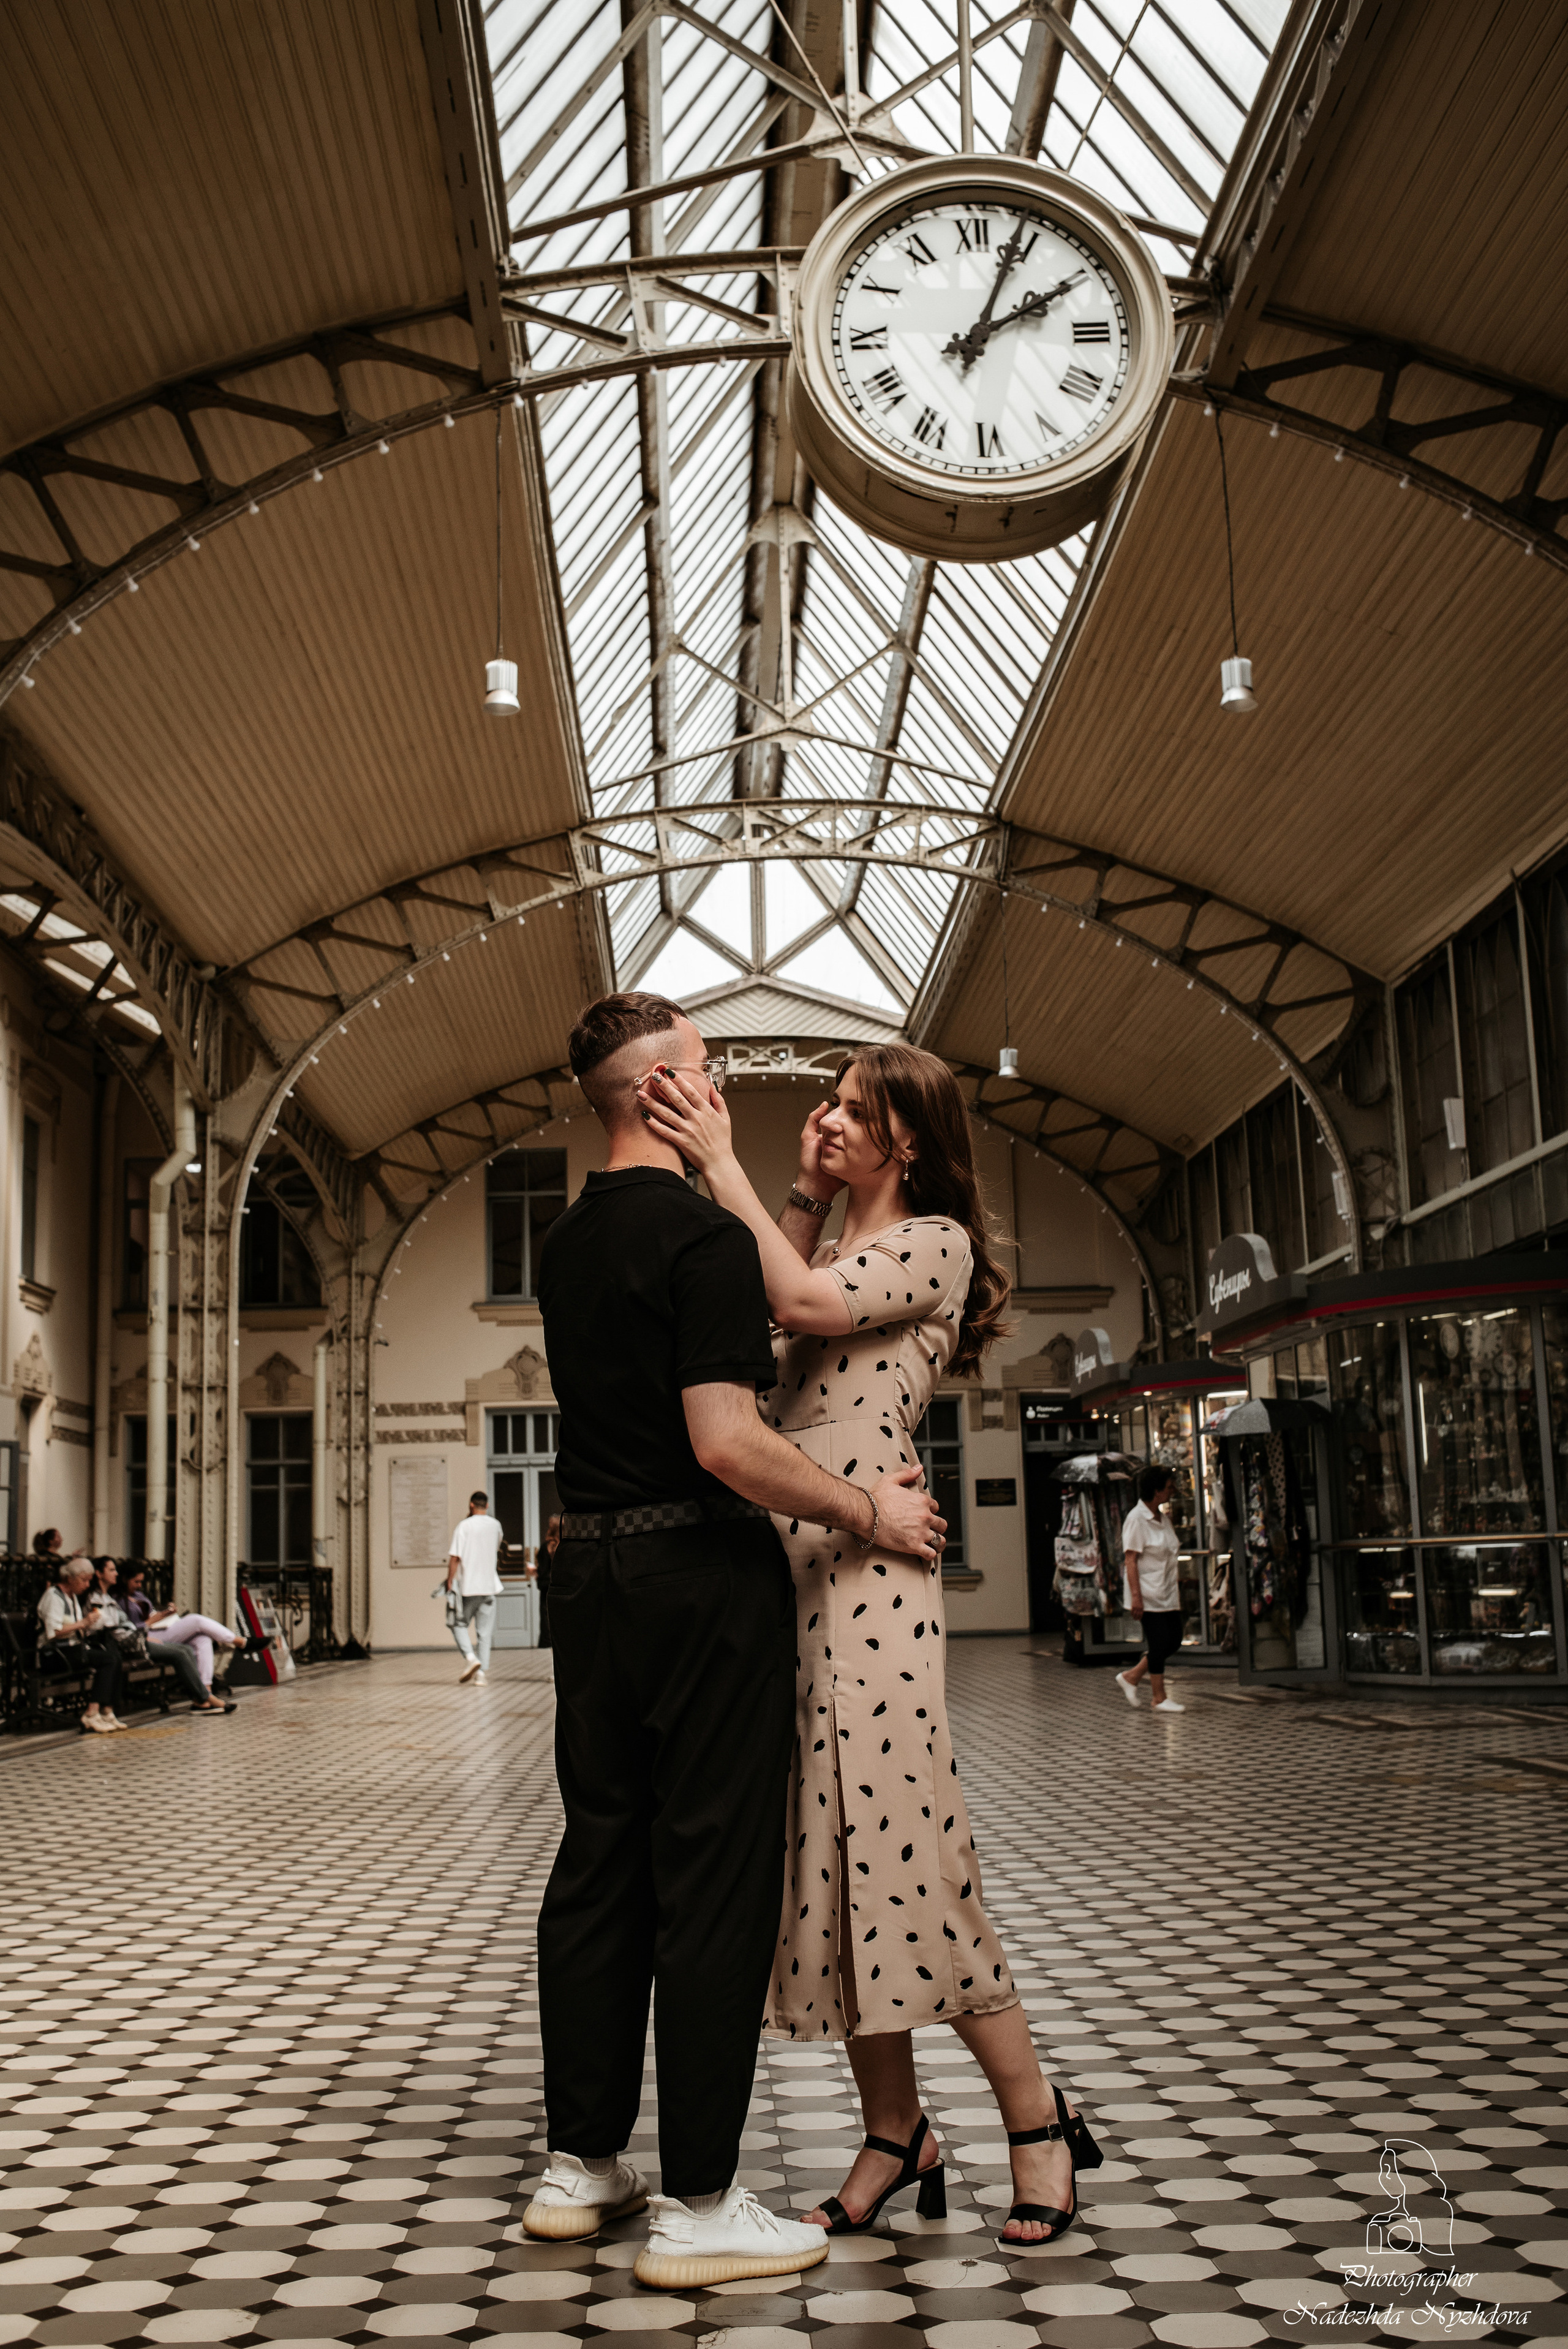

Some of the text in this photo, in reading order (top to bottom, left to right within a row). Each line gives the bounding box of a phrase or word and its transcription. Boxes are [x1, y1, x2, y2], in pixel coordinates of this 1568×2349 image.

[893, 232, 940, 275] XI
[952, 218, 990, 255] XII
[859, 272, 903, 306] X
[849, 323, 889, 353] IX
[1071, 319, 1111, 346] III
[861, 362, 910, 417] VIII
[910, 404, 949, 452] VII
[974, 421, 1009, 458] VI
[1033, 409, 1063, 443] V
